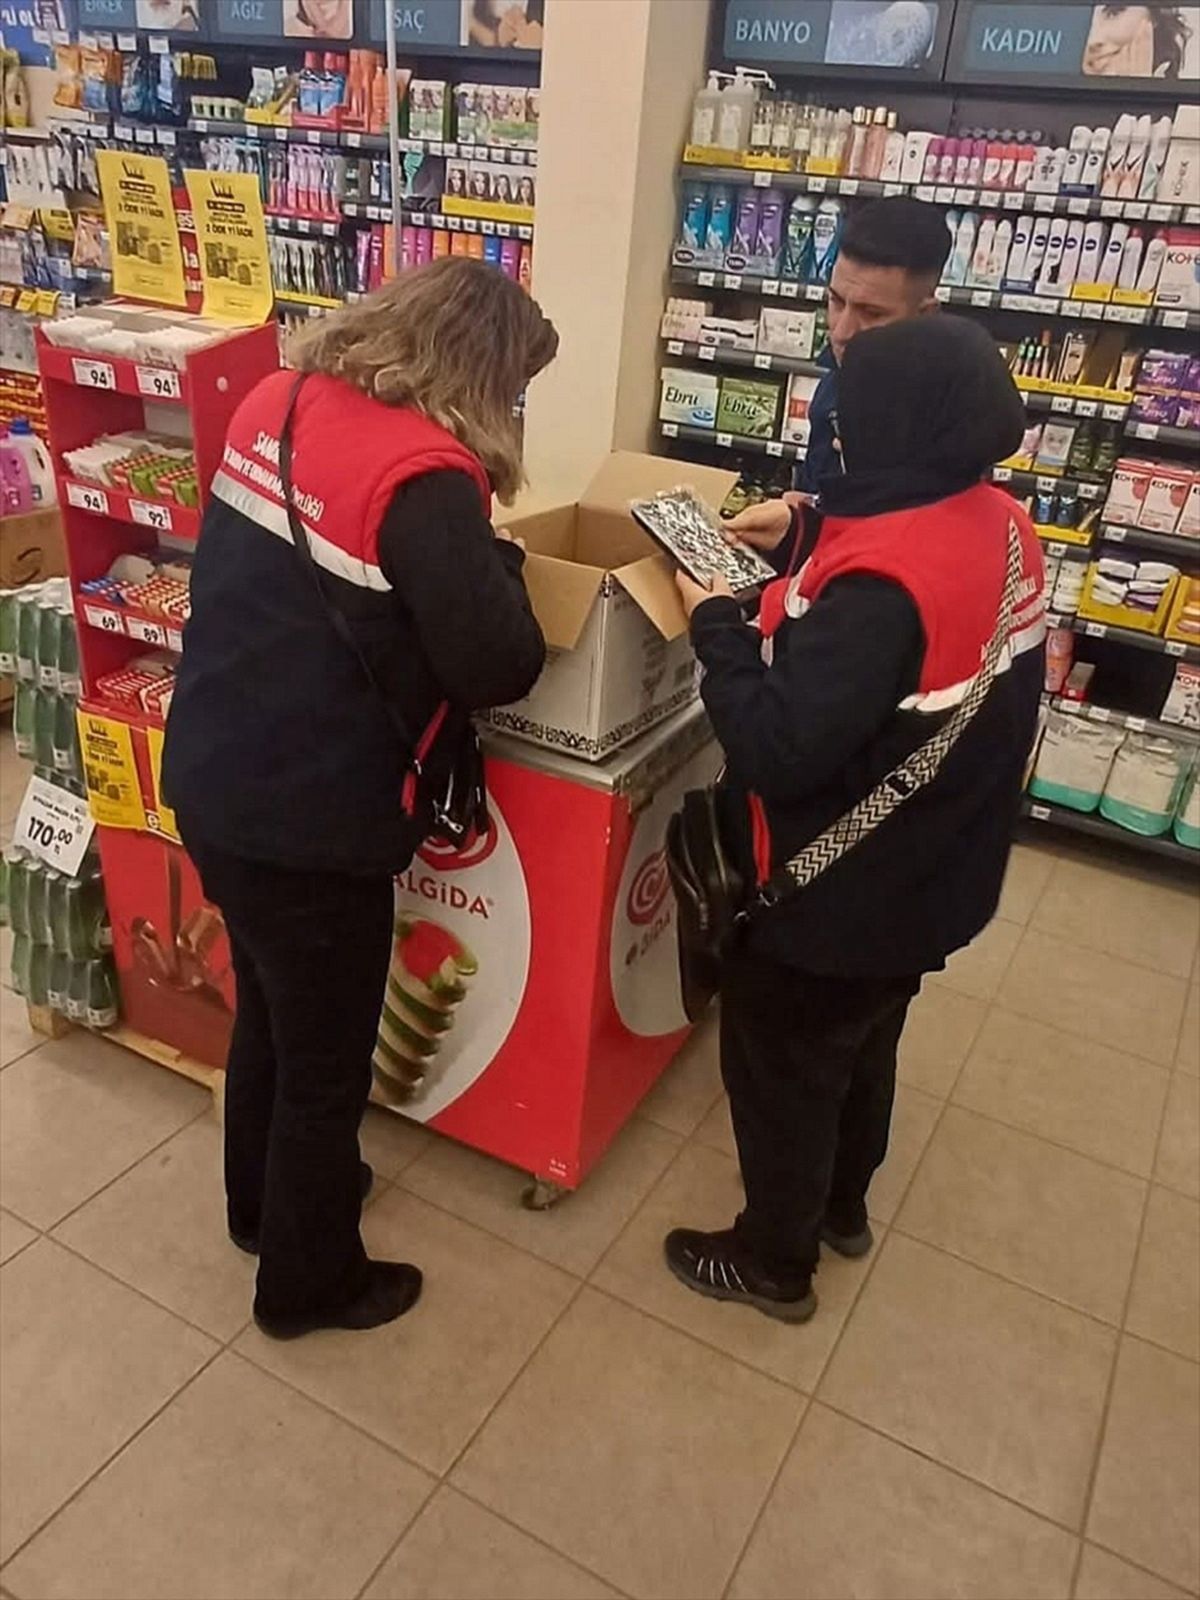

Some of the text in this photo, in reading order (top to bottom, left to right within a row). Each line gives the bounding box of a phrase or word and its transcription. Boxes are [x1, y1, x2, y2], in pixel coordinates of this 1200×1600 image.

[394, 9, 425, 34] SAÇ
[734, 19, 811, 45] BANYO
[981, 27, 1062, 55] KADIN
[91, 369, 108, 386] 94
[154, 378, 172, 395] 94
[665, 386, 698, 405] Ebru
[723, 395, 760, 419] Ebru
[84, 493, 101, 510] 94
[149, 511, 165, 527] 92
[102, 615, 116, 629] 69
